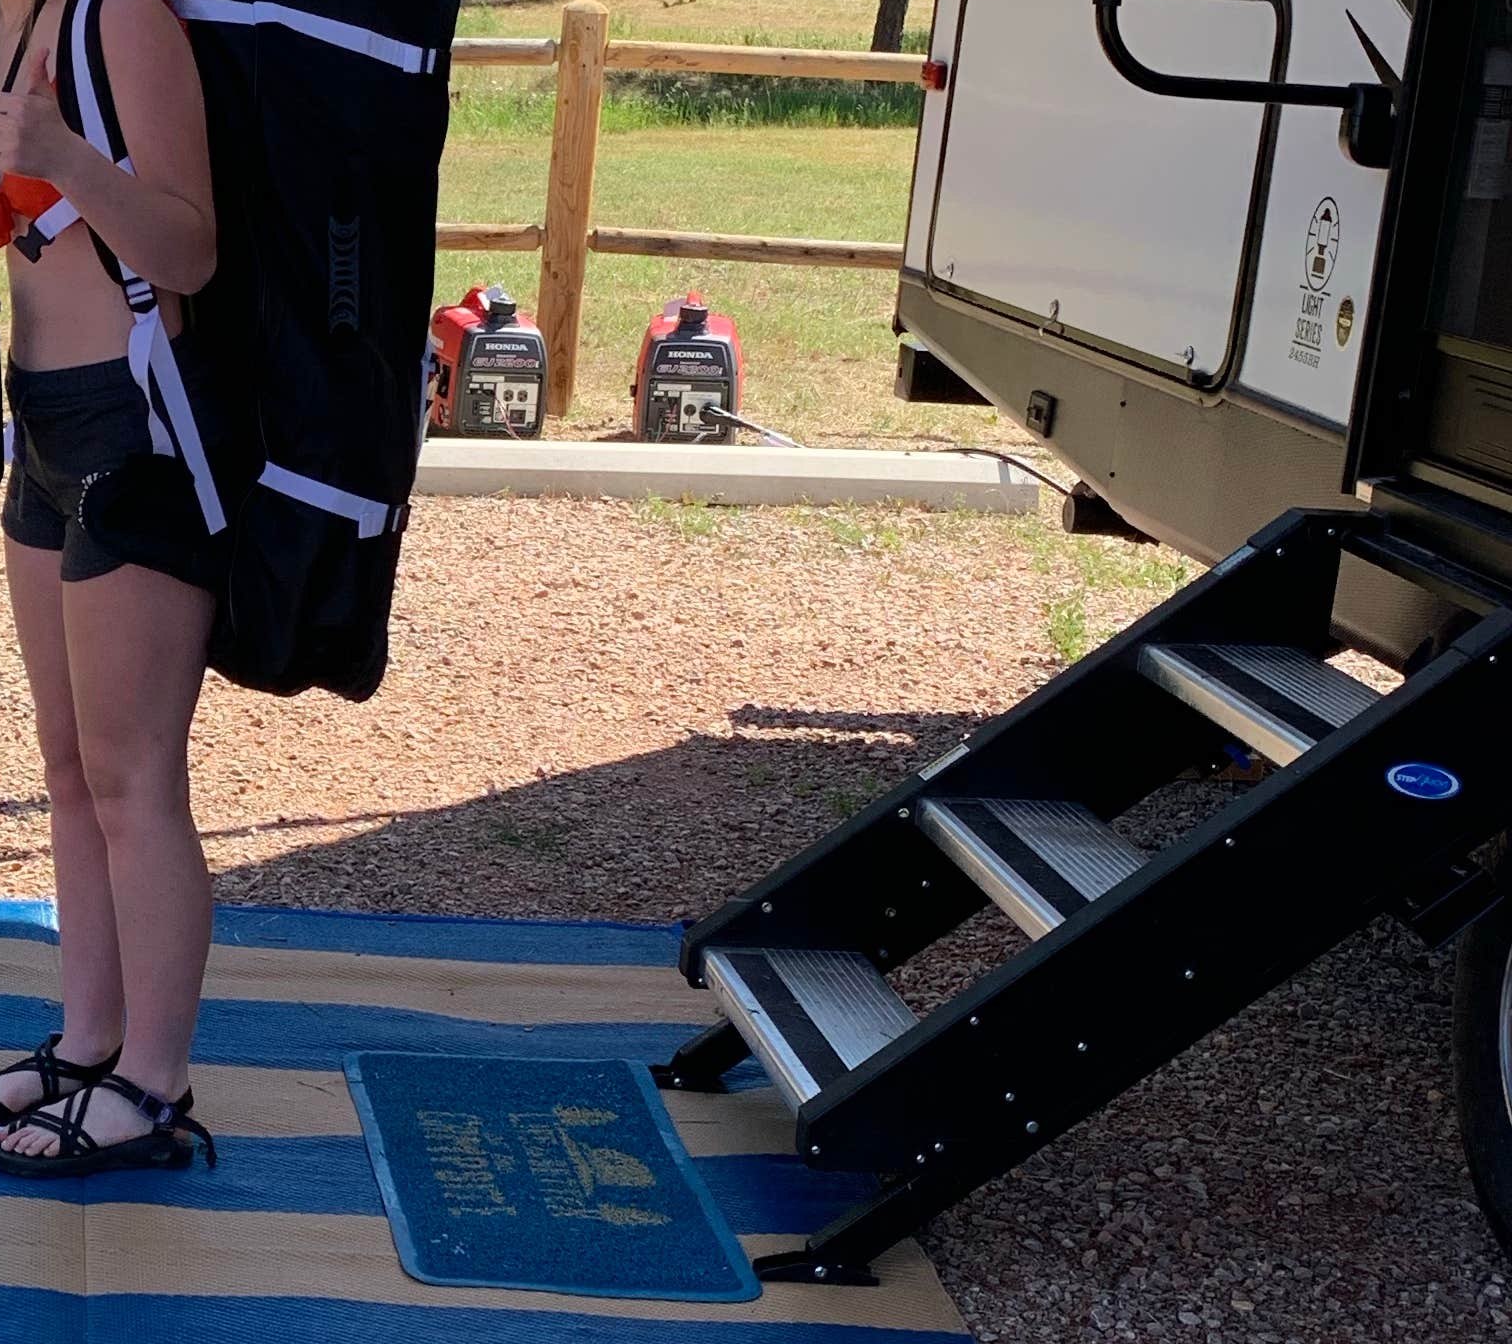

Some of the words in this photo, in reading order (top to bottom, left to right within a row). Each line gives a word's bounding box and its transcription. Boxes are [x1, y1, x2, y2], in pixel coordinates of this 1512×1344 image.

[1301, 292, 1324, 319] LIGHT
[1295, 317, 1323, 346] SERIES
[485, 343, 528, 351] HONDA
[668, 350, 714, 359] HONDA
